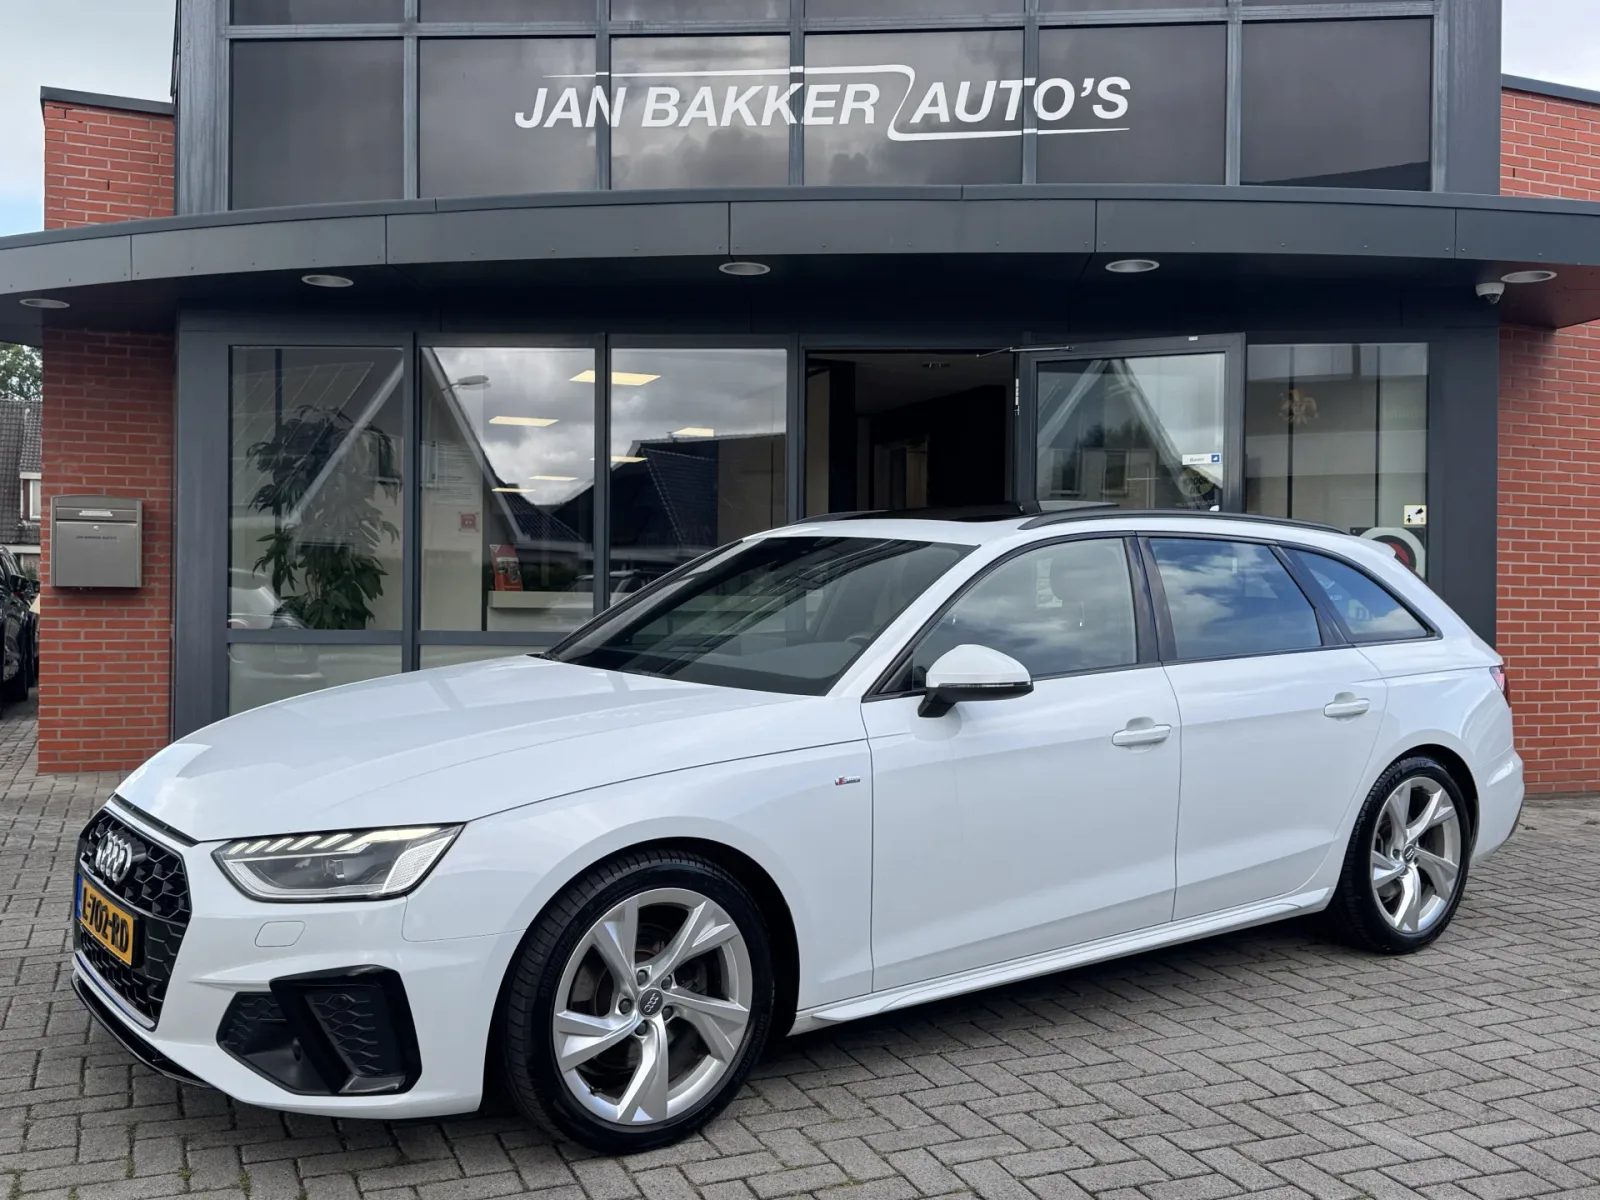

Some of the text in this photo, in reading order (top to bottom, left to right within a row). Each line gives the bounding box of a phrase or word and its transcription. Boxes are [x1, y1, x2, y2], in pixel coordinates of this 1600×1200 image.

[514, 76, 1131, 129] JAN BAKKER AUTO'S
[82, 886, 130, 954] L-702-RD
